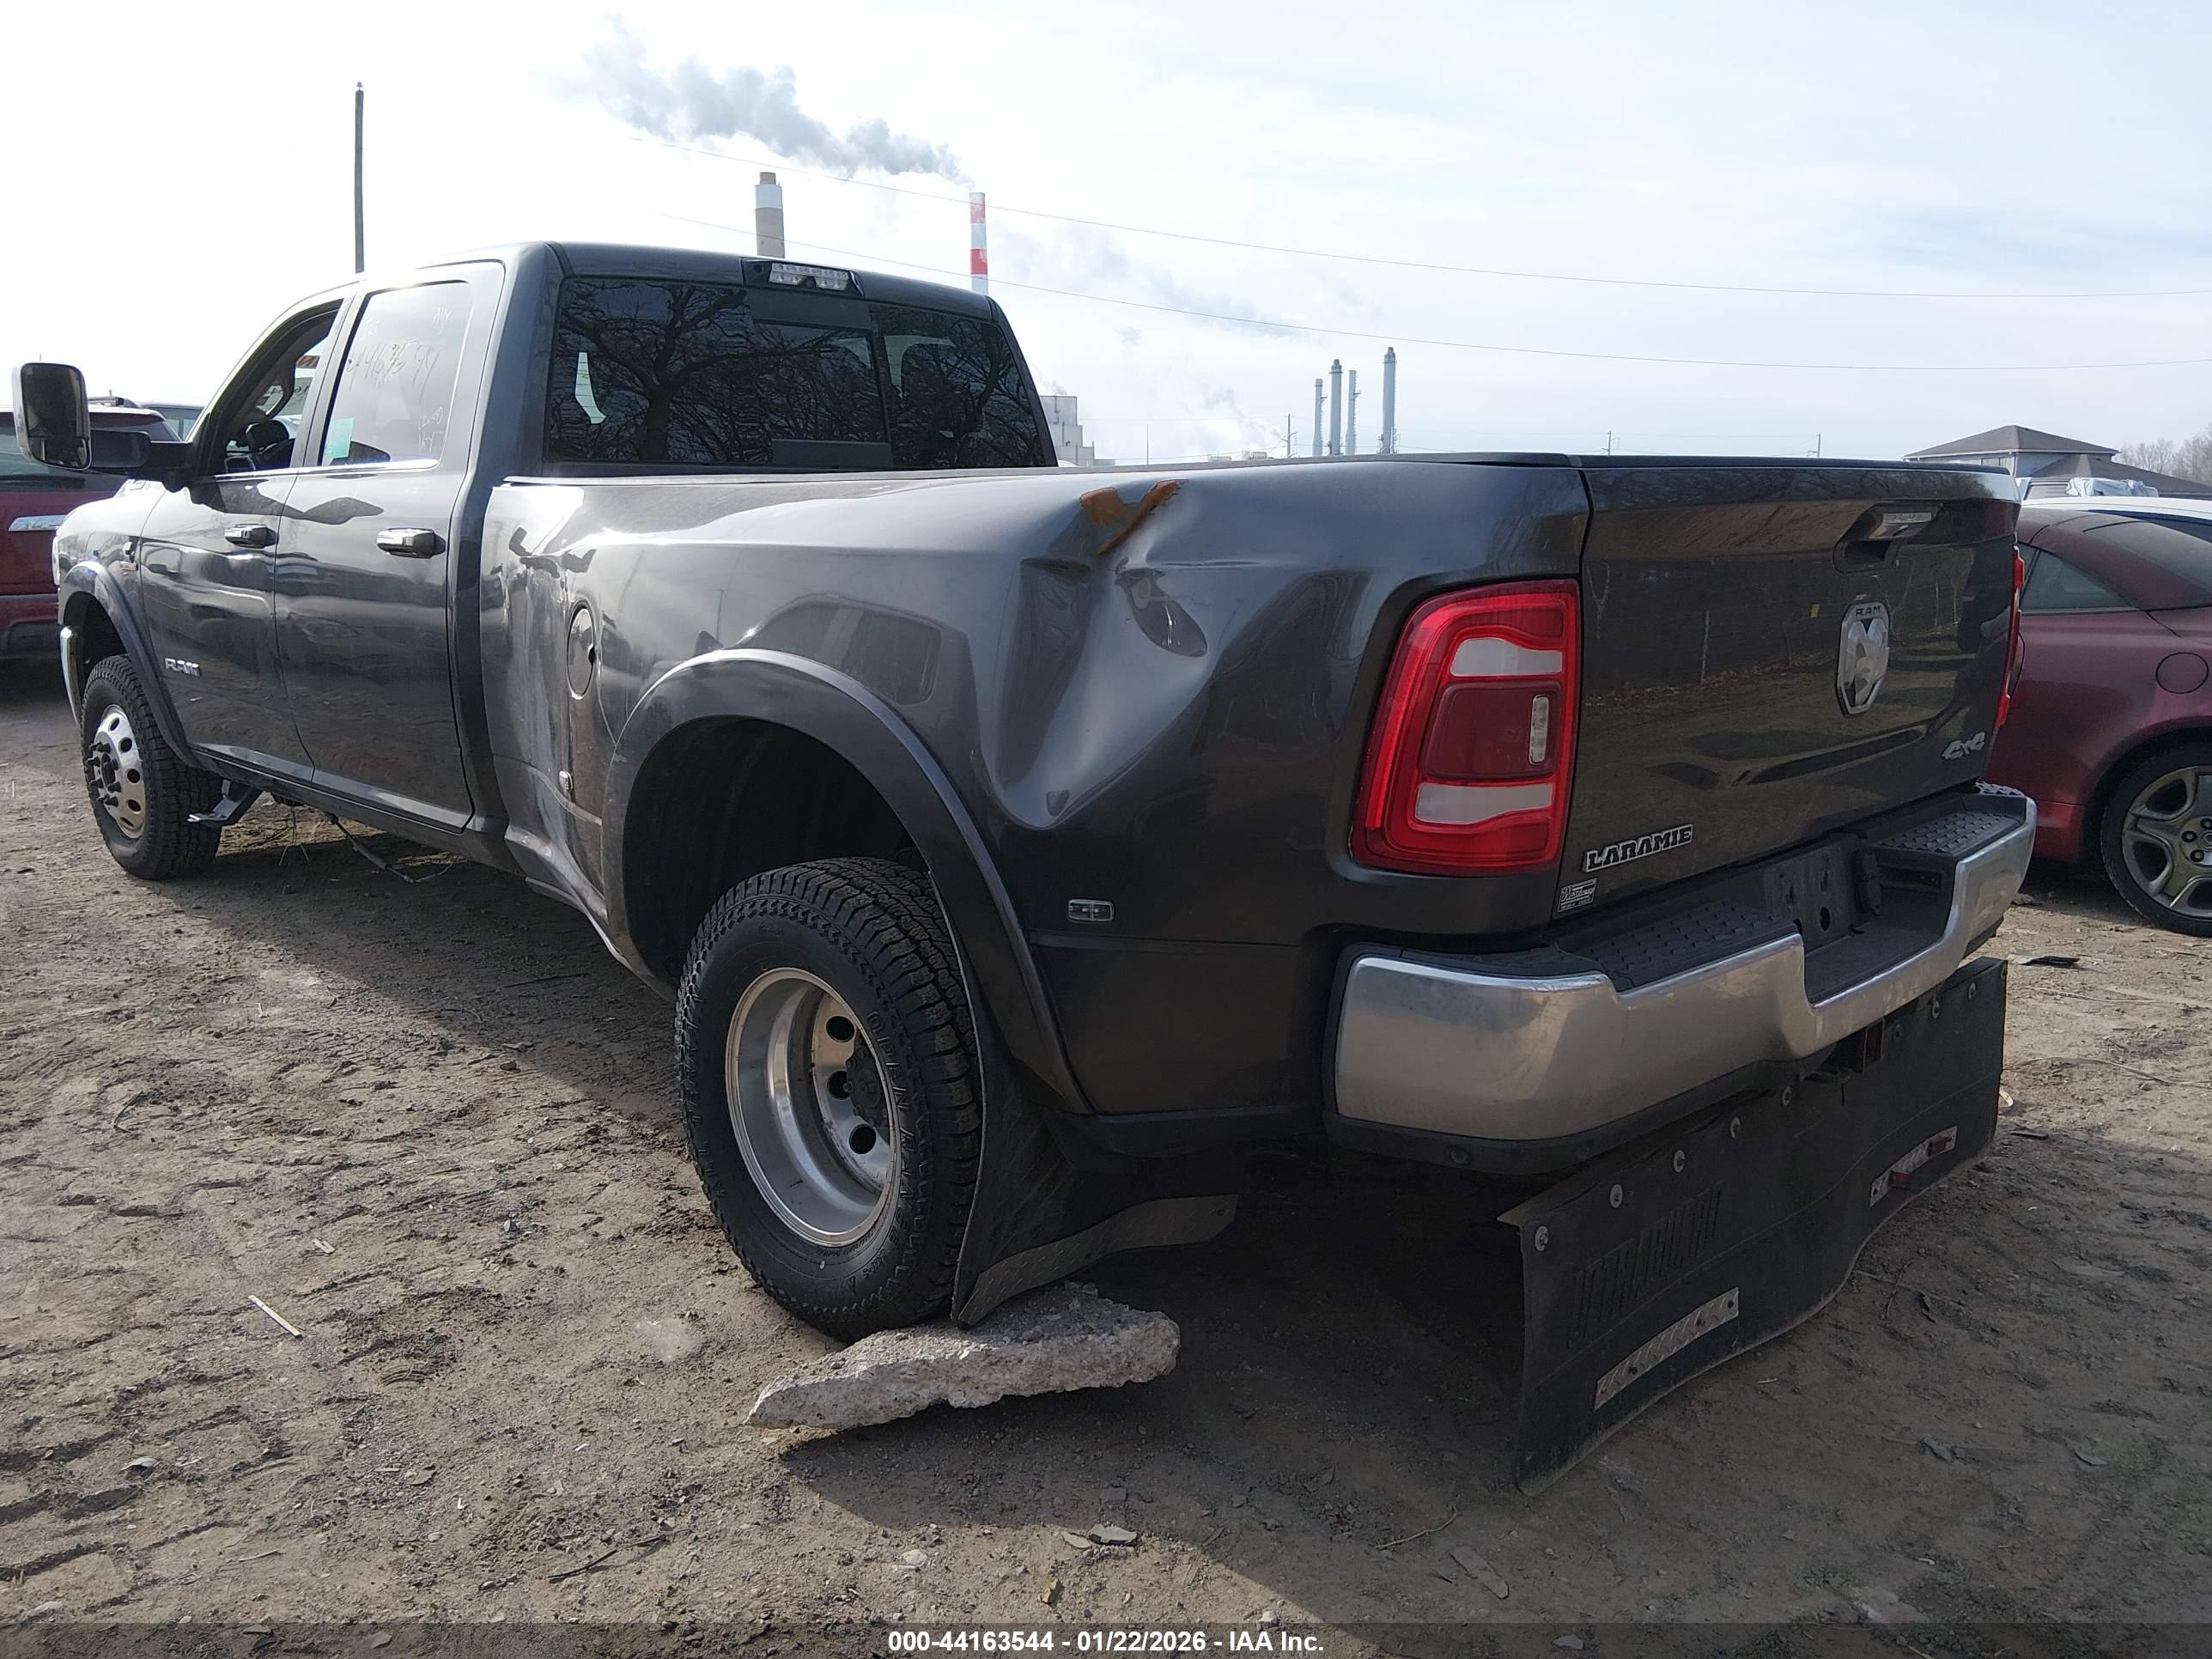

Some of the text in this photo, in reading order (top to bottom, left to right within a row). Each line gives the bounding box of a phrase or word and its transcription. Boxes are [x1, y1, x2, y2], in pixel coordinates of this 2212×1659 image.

[1855, 605, 1881, 617] RAM
[164, 657, 201, 678] RAM
[1583, 823, 1693, 873] LARAMIE
